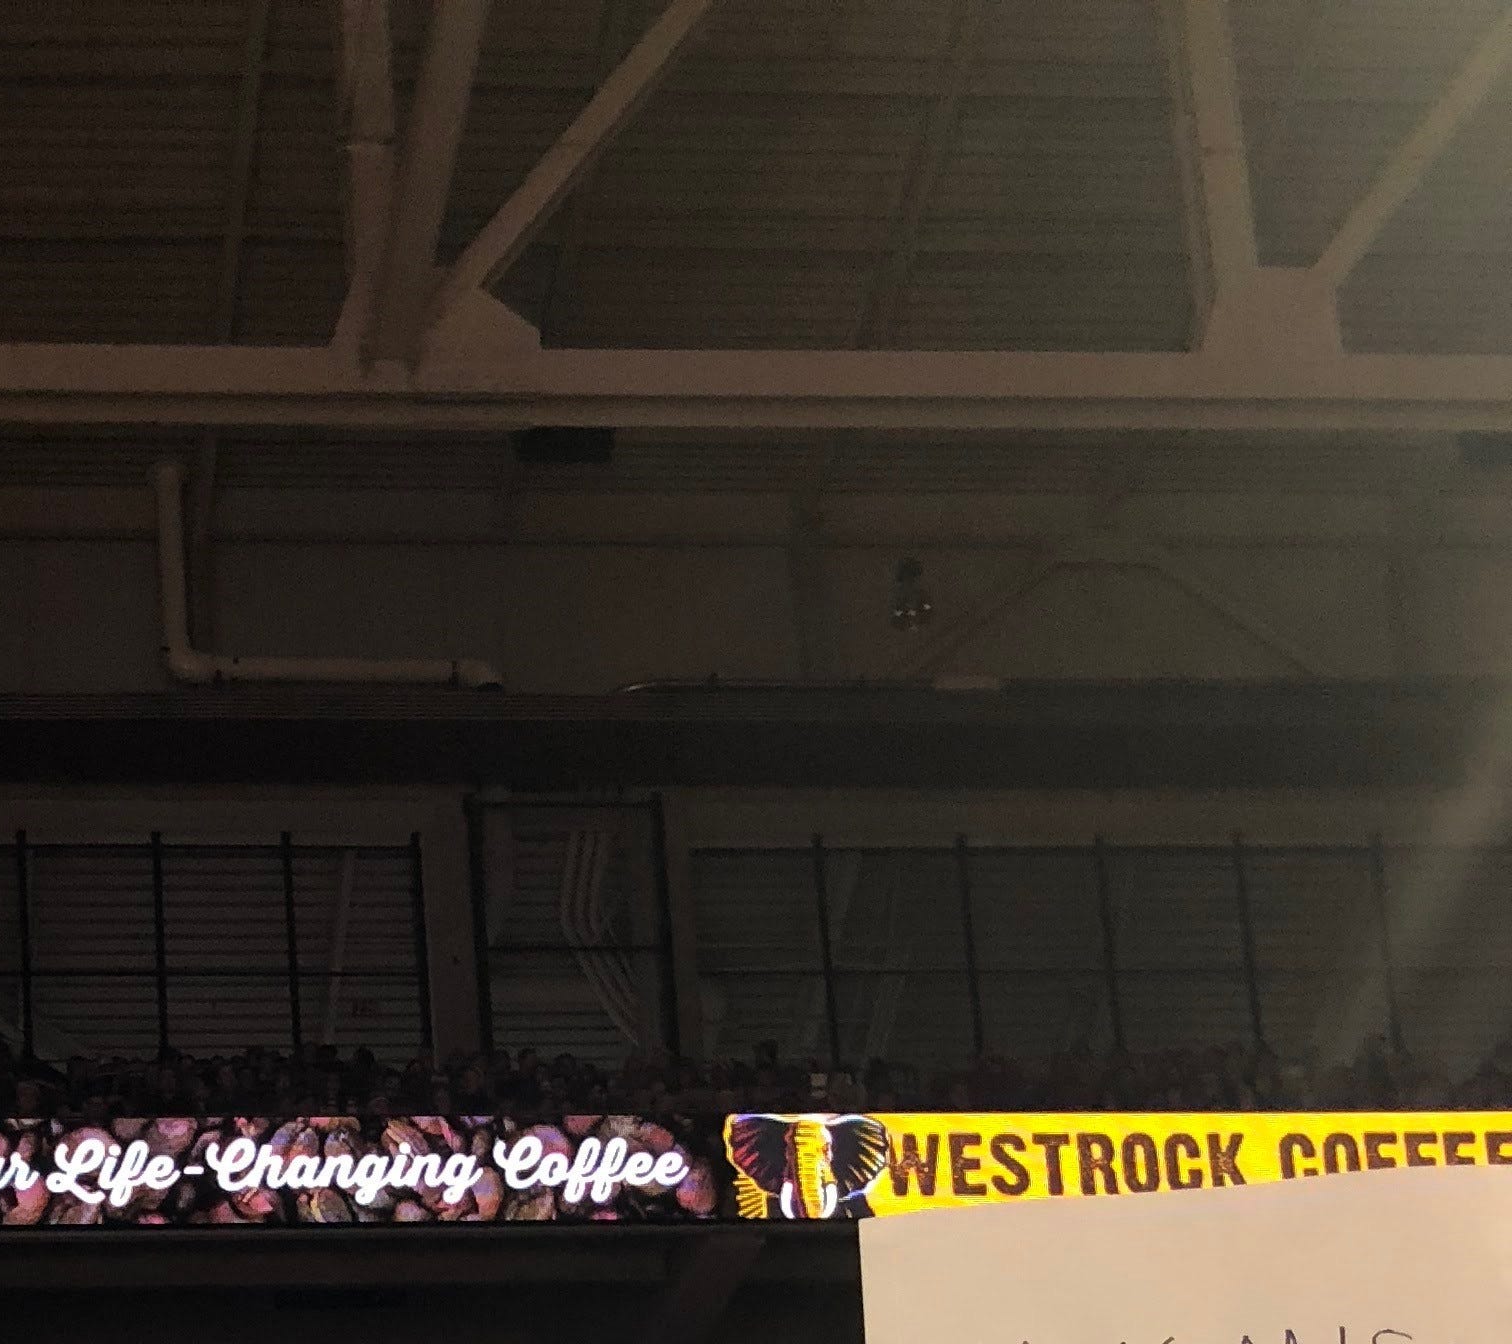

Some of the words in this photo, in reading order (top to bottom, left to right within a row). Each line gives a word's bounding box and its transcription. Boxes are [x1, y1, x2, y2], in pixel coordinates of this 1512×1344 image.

[45, 1137, 483, 1208] Life-Changing
[492, 1135, 690, 1204] Coffee
[891, 1132, 1247, 1198] WESTROCK
